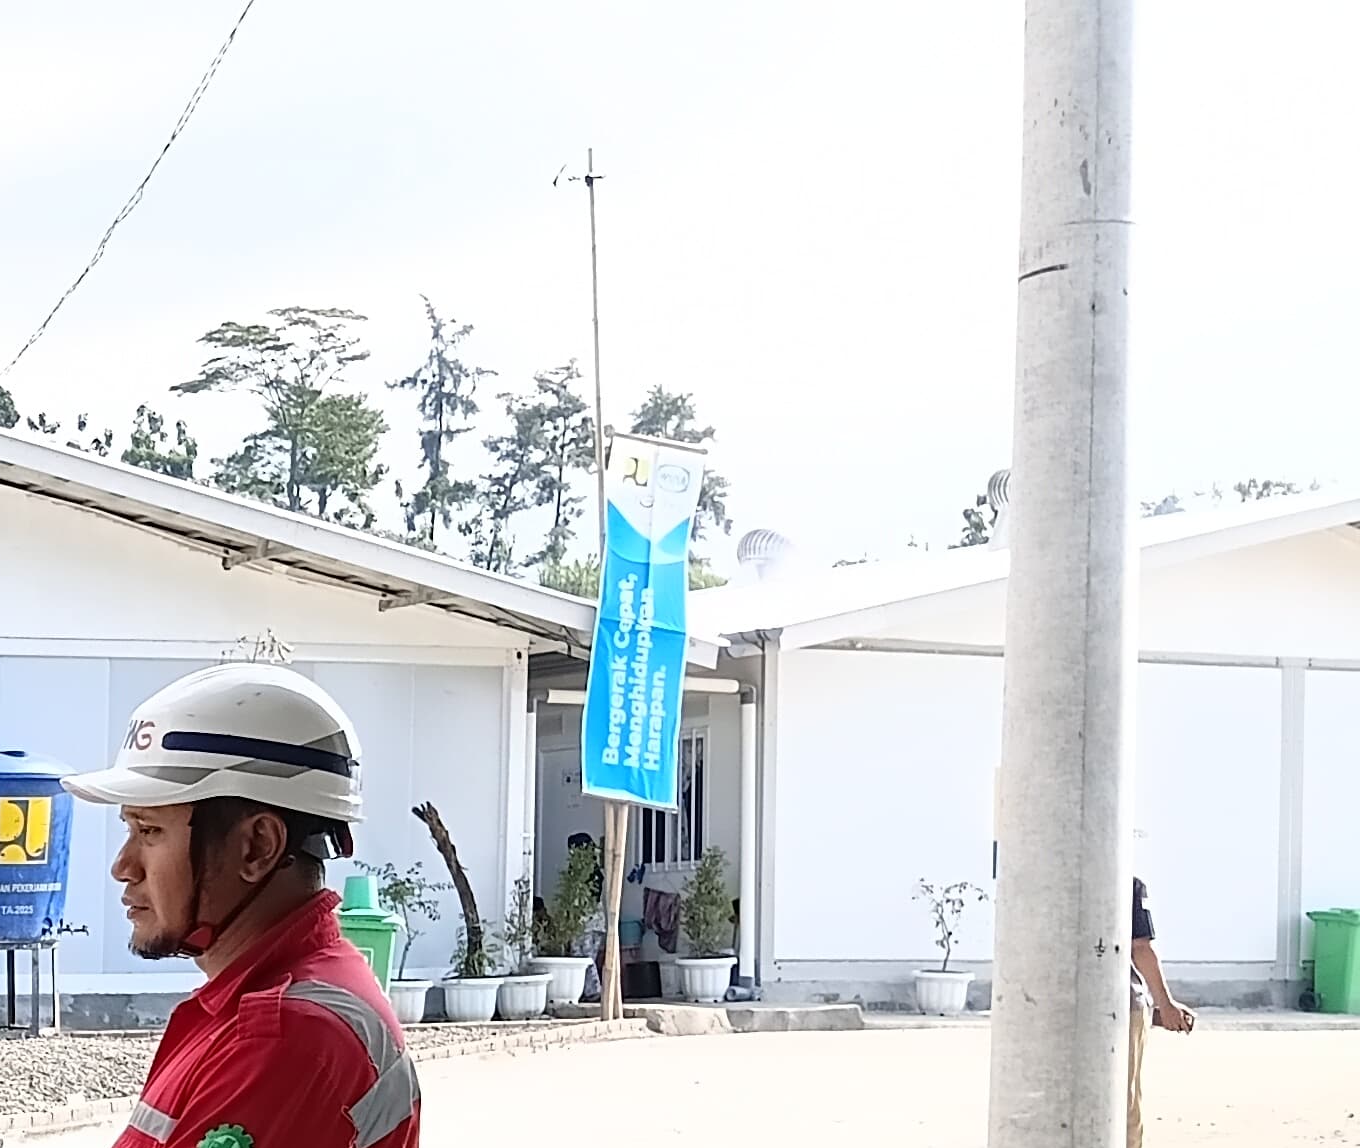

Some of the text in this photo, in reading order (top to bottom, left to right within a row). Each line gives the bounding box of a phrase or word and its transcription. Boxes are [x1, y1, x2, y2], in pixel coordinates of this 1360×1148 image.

[602, 654, 628, 765] Bergerak
[623, 588, 655, 769] Menghidupkan
[643, 664, 667, 771] Harapan.
